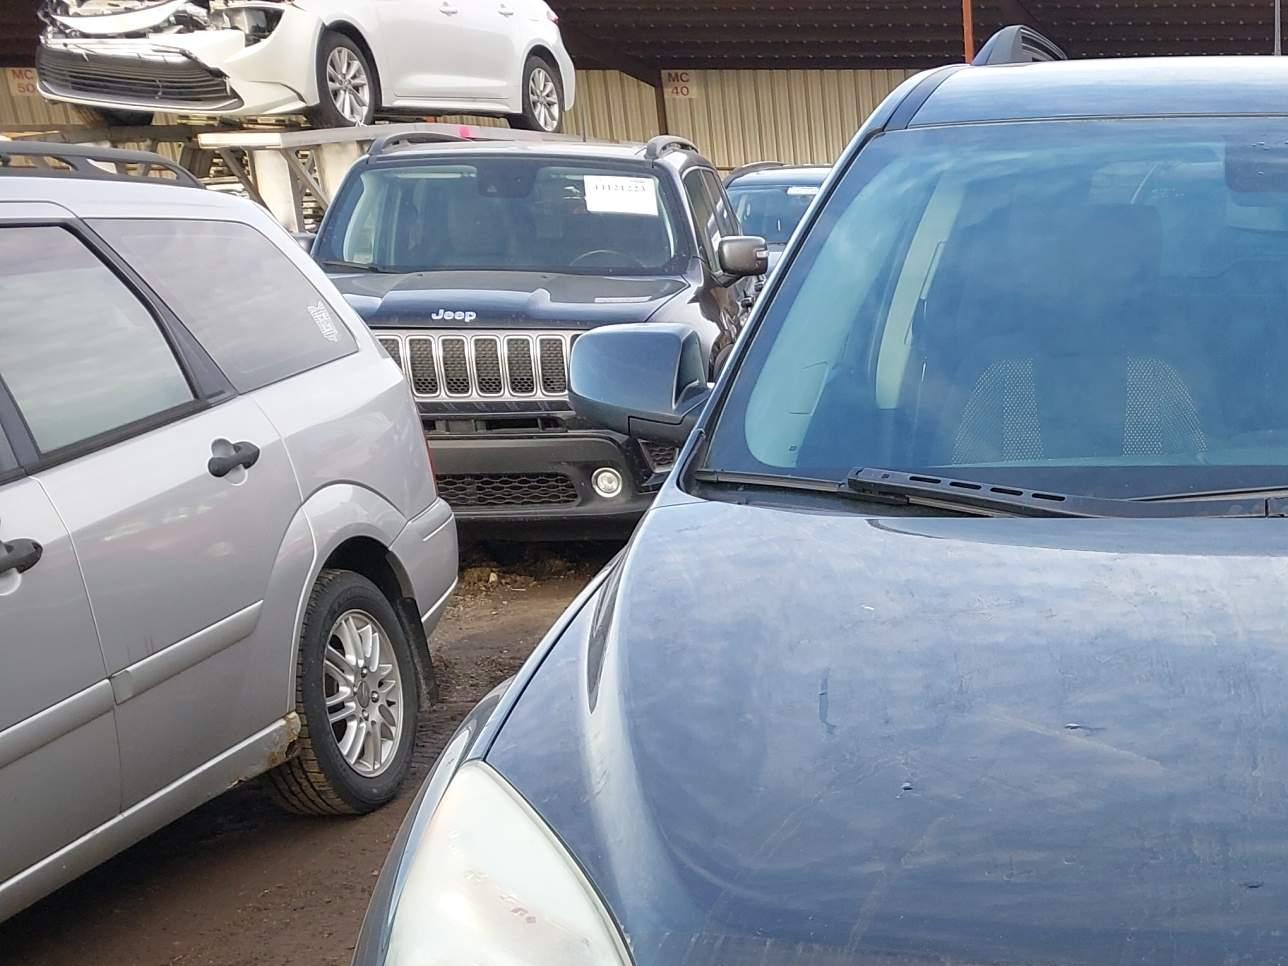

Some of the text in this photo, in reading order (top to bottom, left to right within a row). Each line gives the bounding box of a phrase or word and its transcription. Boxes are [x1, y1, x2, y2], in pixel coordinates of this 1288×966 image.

[10, 69, 33, 80] MC
[667, 72, 689, 83] MC
[17, 83, 35, 94] 50
[671, 86, 689, 97] 40
[431, 308, 477, 323] Jeep
